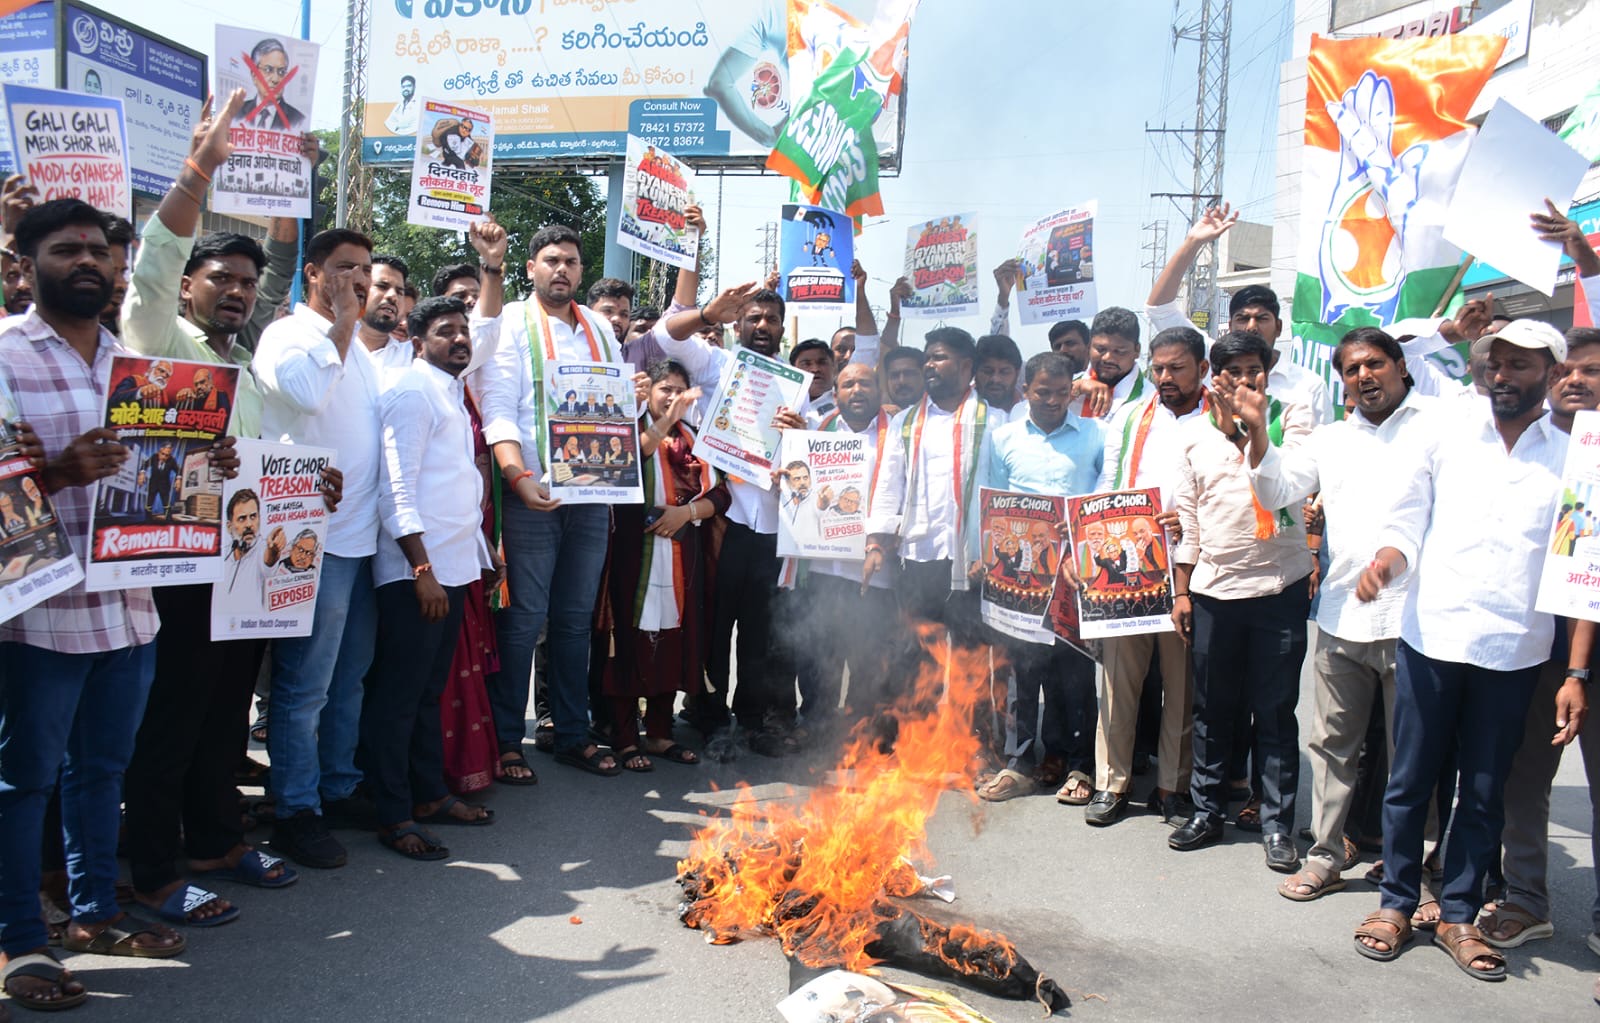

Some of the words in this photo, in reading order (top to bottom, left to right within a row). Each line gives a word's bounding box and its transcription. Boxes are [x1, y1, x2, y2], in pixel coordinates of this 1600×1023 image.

[560, 21, 709, 51] కరిగించేయండి
[443, 70, 500, 96] ఆరోగ్యశ్రీ
[504, 70, 524, 89] తో
[531, 72, 572, 88] ఉచిత
[575, 68, 618, 87] సేవలు
[622, 66, 641, 86] మీ
[643, 101, 678, 111] Consult
[680, 101, 701, 111] Now
[25, 110, 67, 132] GALI
[71, 111, 111, 133] GALI
[640, 122, 670, 133] 78421
[673, 122, 705, 133] 57372
[25, 134, 59, 154] MEIN
[62, 134, 96, 153] SHOR
[257, 130, 280, 153] कुमार
[673, 136, 705, 147] 83674
[28, 161, 123, 187] MODI-GYANESH
[914, 241, 967, 260] GYANESH
[914, 252, 964, 270] KUMAR
[808, 438, 832, 453] VOTE
[833, 439, 862, 452] CHORI
[261, 454, 292, 476] VOTE
[808, 452, 851, 467] TREASON
[259, 475, 314, 499] TREASON
[266, 503, 281, 514] TIME
[993, 496, 1052, 512] VOTE-CHORI
[1083, 494, 1147, 516] VOTE-CHORI
[825, 524, 863, 537] EXPOSED
[101, 525, 175, 558] Removal
[177, 525, 216, 551] Now
[270, 585, 314, 607] EXPOSED
